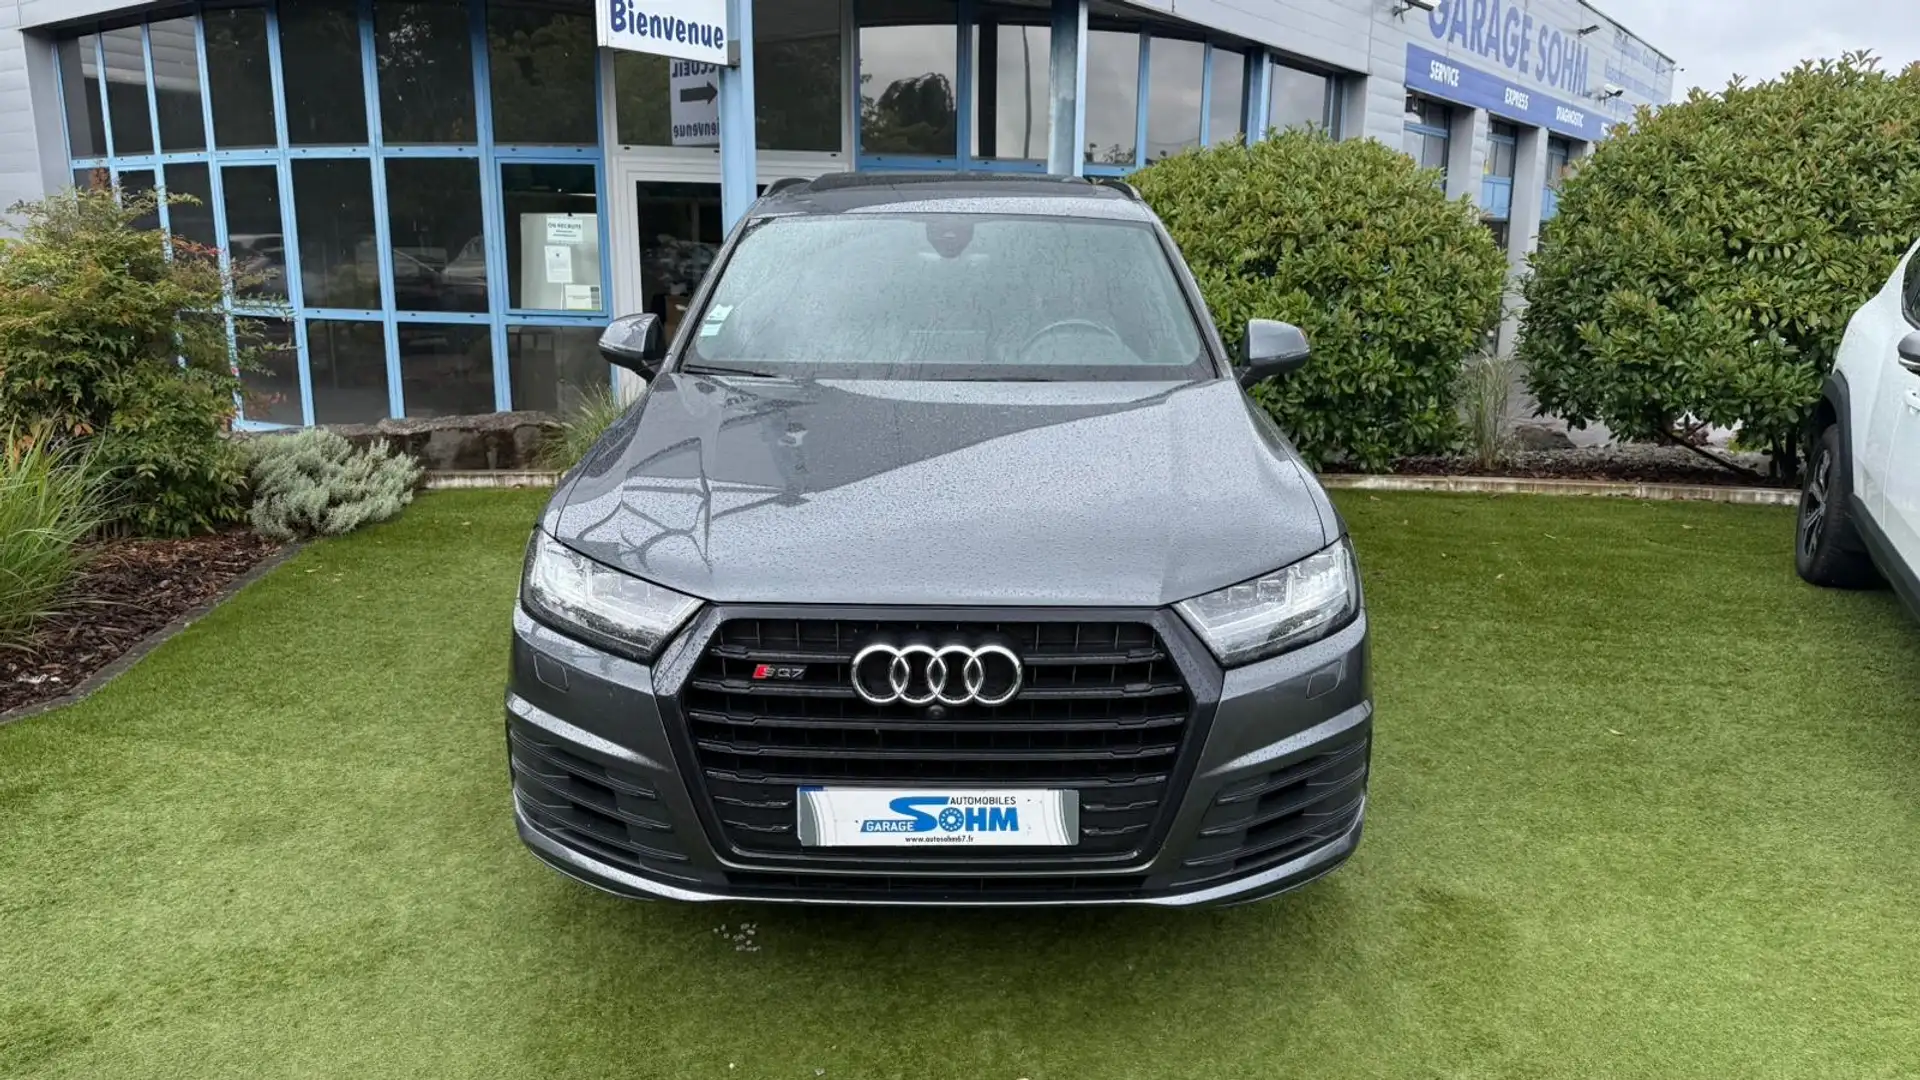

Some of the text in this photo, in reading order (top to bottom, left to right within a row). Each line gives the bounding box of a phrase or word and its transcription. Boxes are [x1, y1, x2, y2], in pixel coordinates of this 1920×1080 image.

[610, 0, 724, 50] Bienvenue
[1429, 59, 1460, 87] SERVICE
[1535, 24, 1589, 98] SOHM
[1505, 86, 1530, 111] EXPRESS
[1556, 105, 1585, 128] DIAGNOSTIC
[950, 796, 1017, 805] AUTOMOBILES
[865, 820, 915, 832] GARAGE
[905, 835, 974, 843] www.autosohm67.fr
